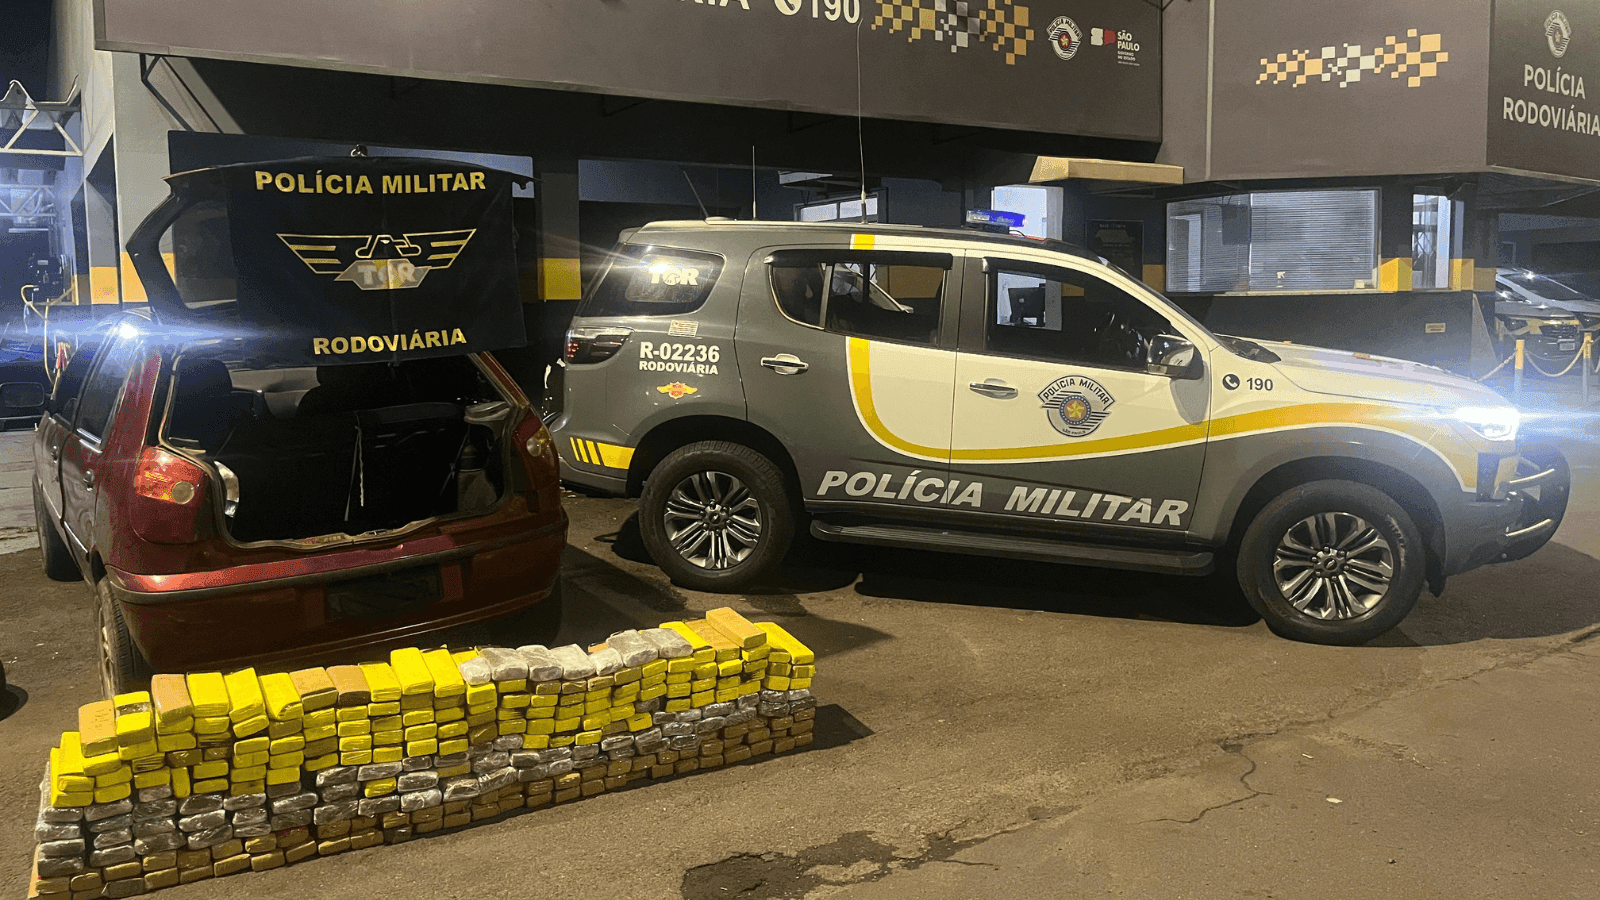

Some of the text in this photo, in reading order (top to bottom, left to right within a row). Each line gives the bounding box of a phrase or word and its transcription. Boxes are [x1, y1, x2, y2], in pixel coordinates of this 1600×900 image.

[1117, 30, 1132, 41] SÃO
[1117, 41, 1140, 52] PAULO
[1524, 64, 1586, 100] POLÍCIA
[1503, 96, 1600, 137] RODOVIÁRIA
[255, 170, 486, 195] POLÍCIA MILITAR
[357, 263, 417, 285] TOR
[313, 328, 467, 355] RODOVIÁRIA
[639, 341, 720, 363] R-02236
[639, 360, 719, 375] RODOVIÁRIA
[1079, 379, 1110, 404] MILITAR
[1246, 377, 1274, 391] 190
[816, 470, 1189, 526] POLÍCIA MILITAR
